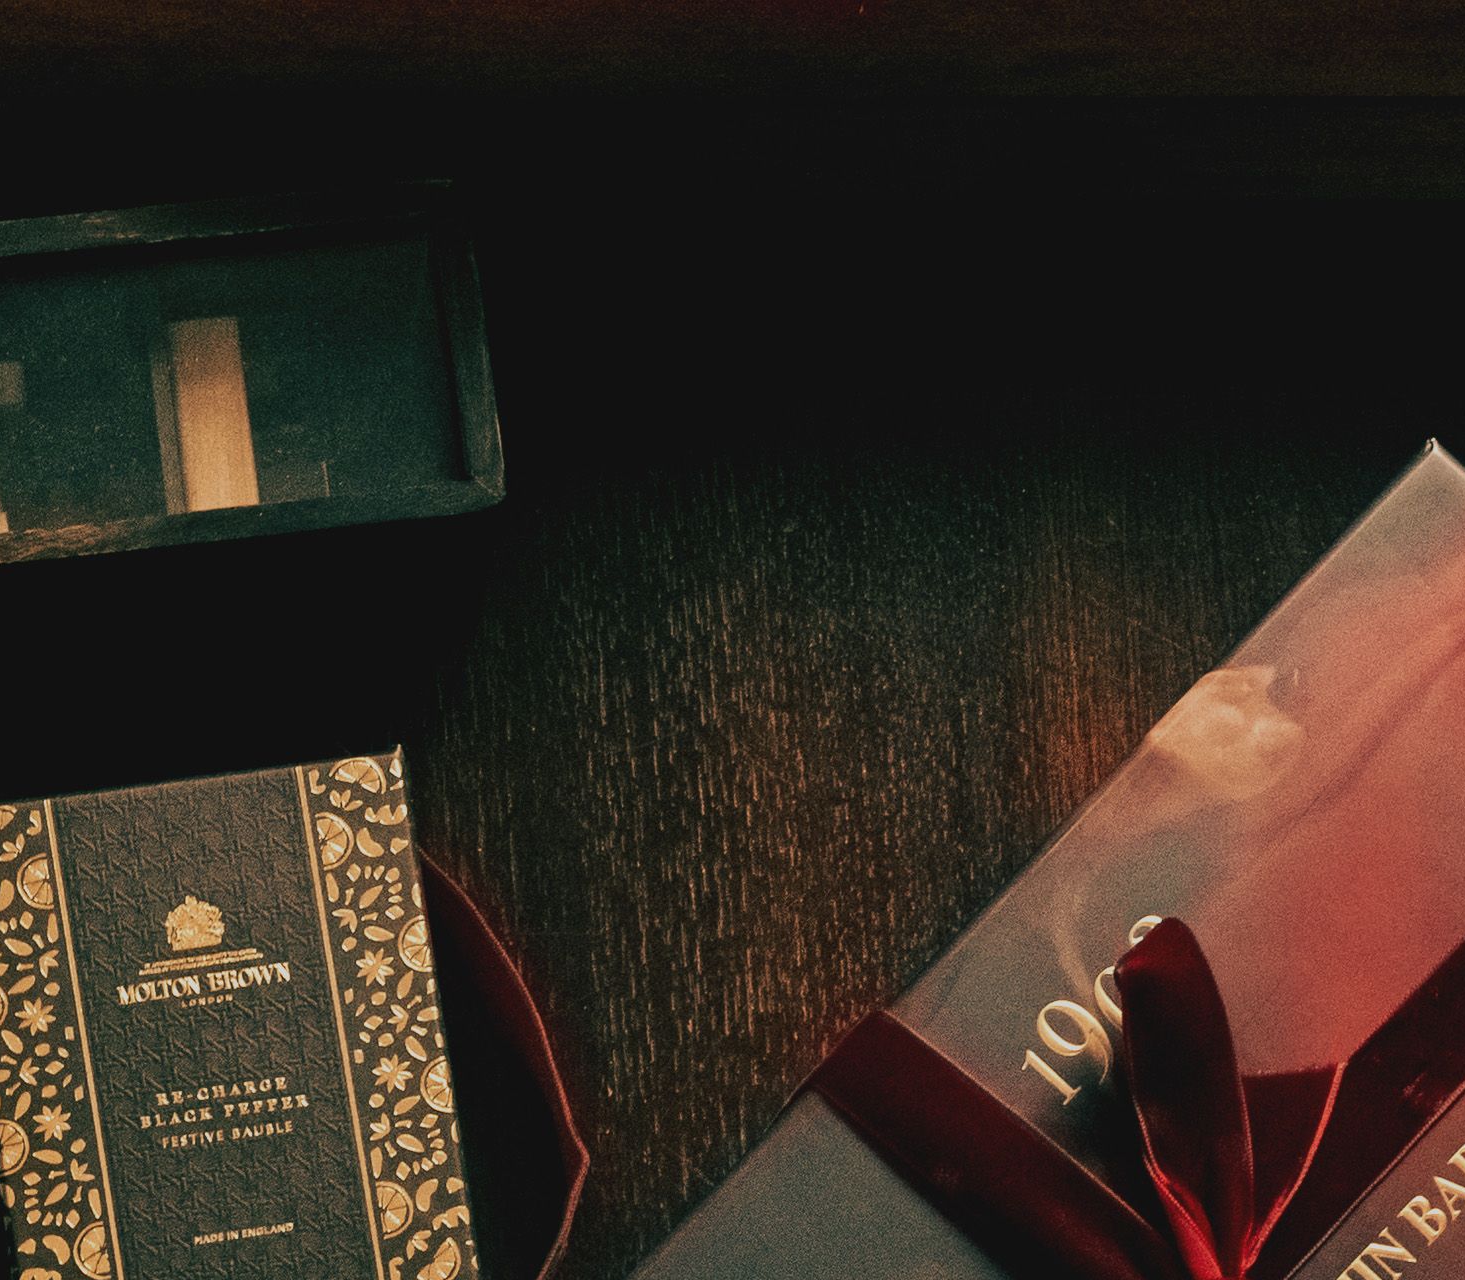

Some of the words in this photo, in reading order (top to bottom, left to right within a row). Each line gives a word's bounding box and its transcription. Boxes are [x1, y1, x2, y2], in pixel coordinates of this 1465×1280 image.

[116, 974, 201, 1006] MOLTON
[206, 961, 291, 993] BROWN
[180, 993, 234, 1009] LONDON
[155, 1076, 288, 1107] RE-CHARGE
[139, 1106, 214, 1130] BLACK
[223, 1094, 310, 1118] PEPPER
[162, 1129, 225, 1149] FESTIVE
[231, 1120, 295, 1141] BAUBLE
[193, 1231, 224, 1246] MADE
[226, 1230, 240, 1241] IN
[241, 1222, 295, 1239] ENGLAND
